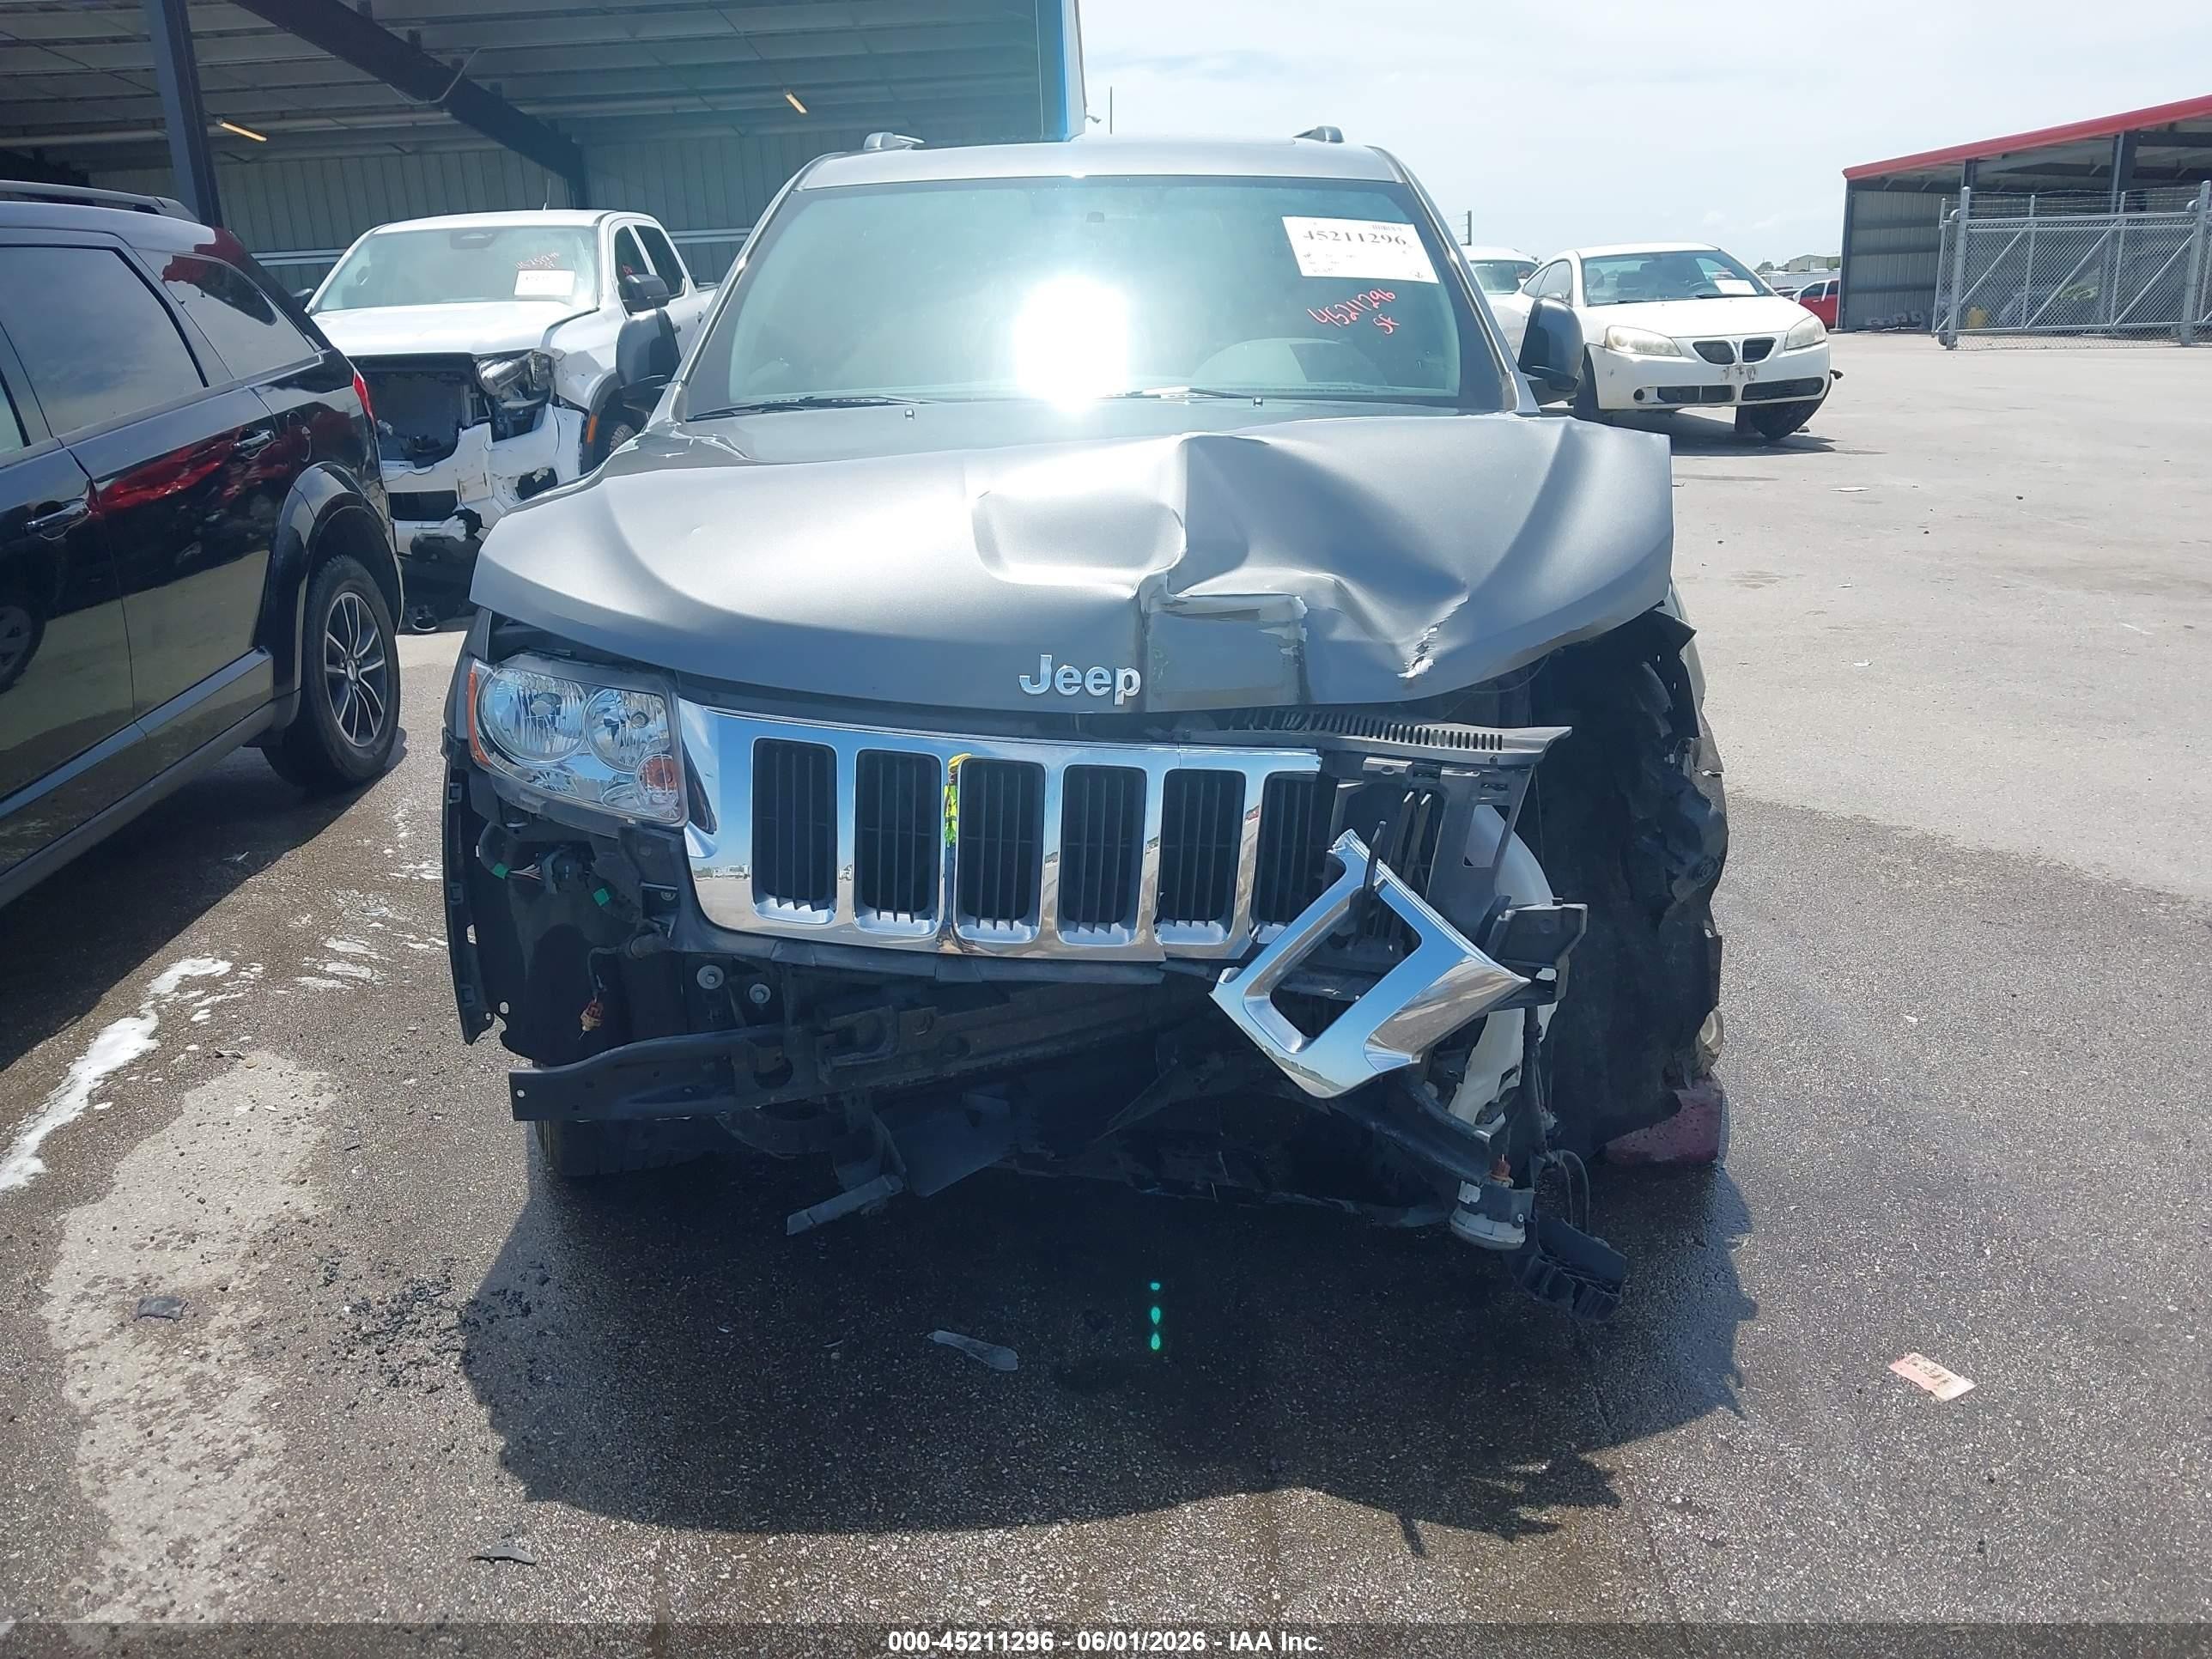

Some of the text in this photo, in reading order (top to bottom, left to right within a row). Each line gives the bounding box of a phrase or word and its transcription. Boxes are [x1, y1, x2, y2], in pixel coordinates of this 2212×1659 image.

[1303, 229, 1407, 246] 45211296
[1307, 289, 1395, 327] 45211296
[1019, 654, 1141, 706] Jeep
